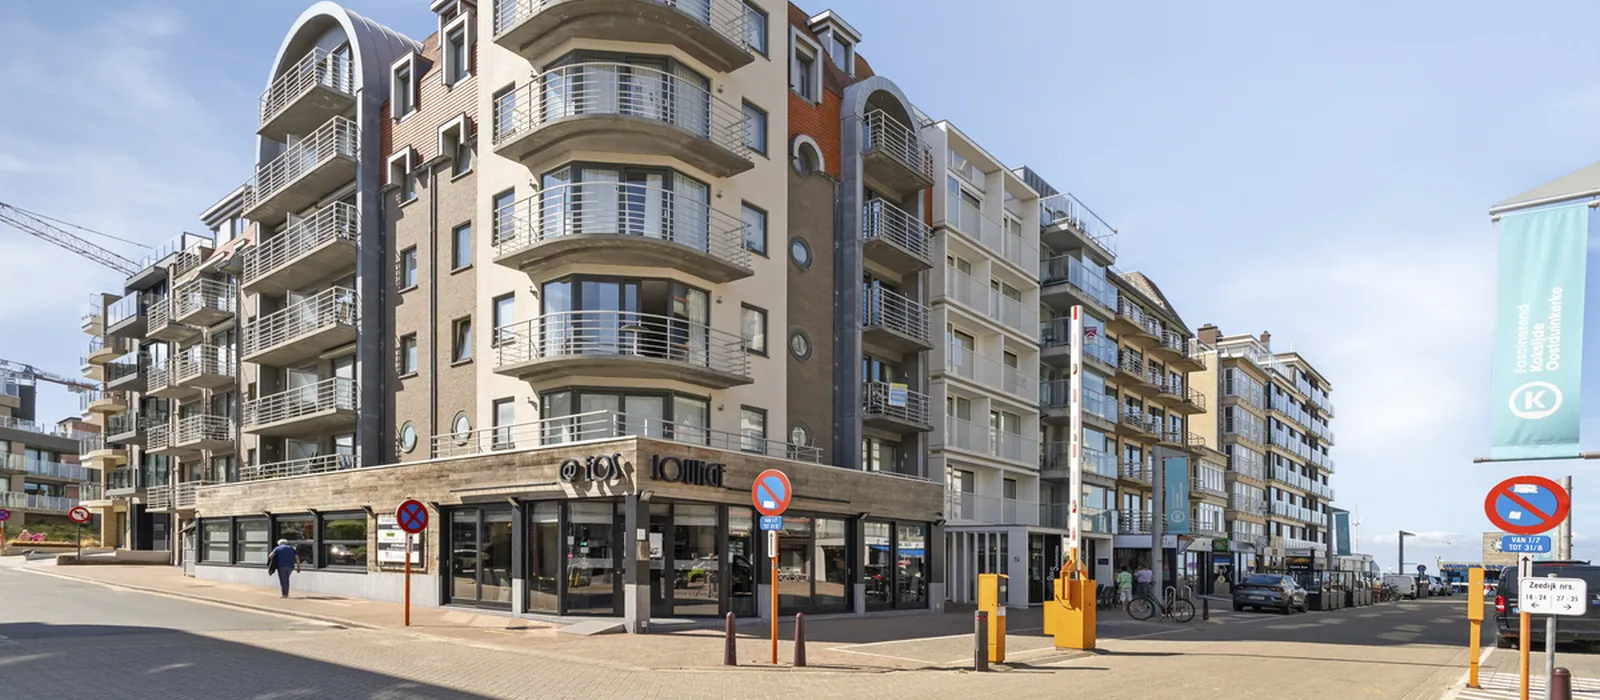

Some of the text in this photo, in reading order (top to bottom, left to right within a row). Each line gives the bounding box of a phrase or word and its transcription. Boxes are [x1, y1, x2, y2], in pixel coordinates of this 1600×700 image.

[1514, 304, 1529, 374] Fascinerend
[1530, 323, 1546, 372] Koksijde
[1546, 286, 1563, 371] Oostduinkerke
[1525, 390, 1546, 410] K
[1529, 581, 1556, 591] Zeedijk
